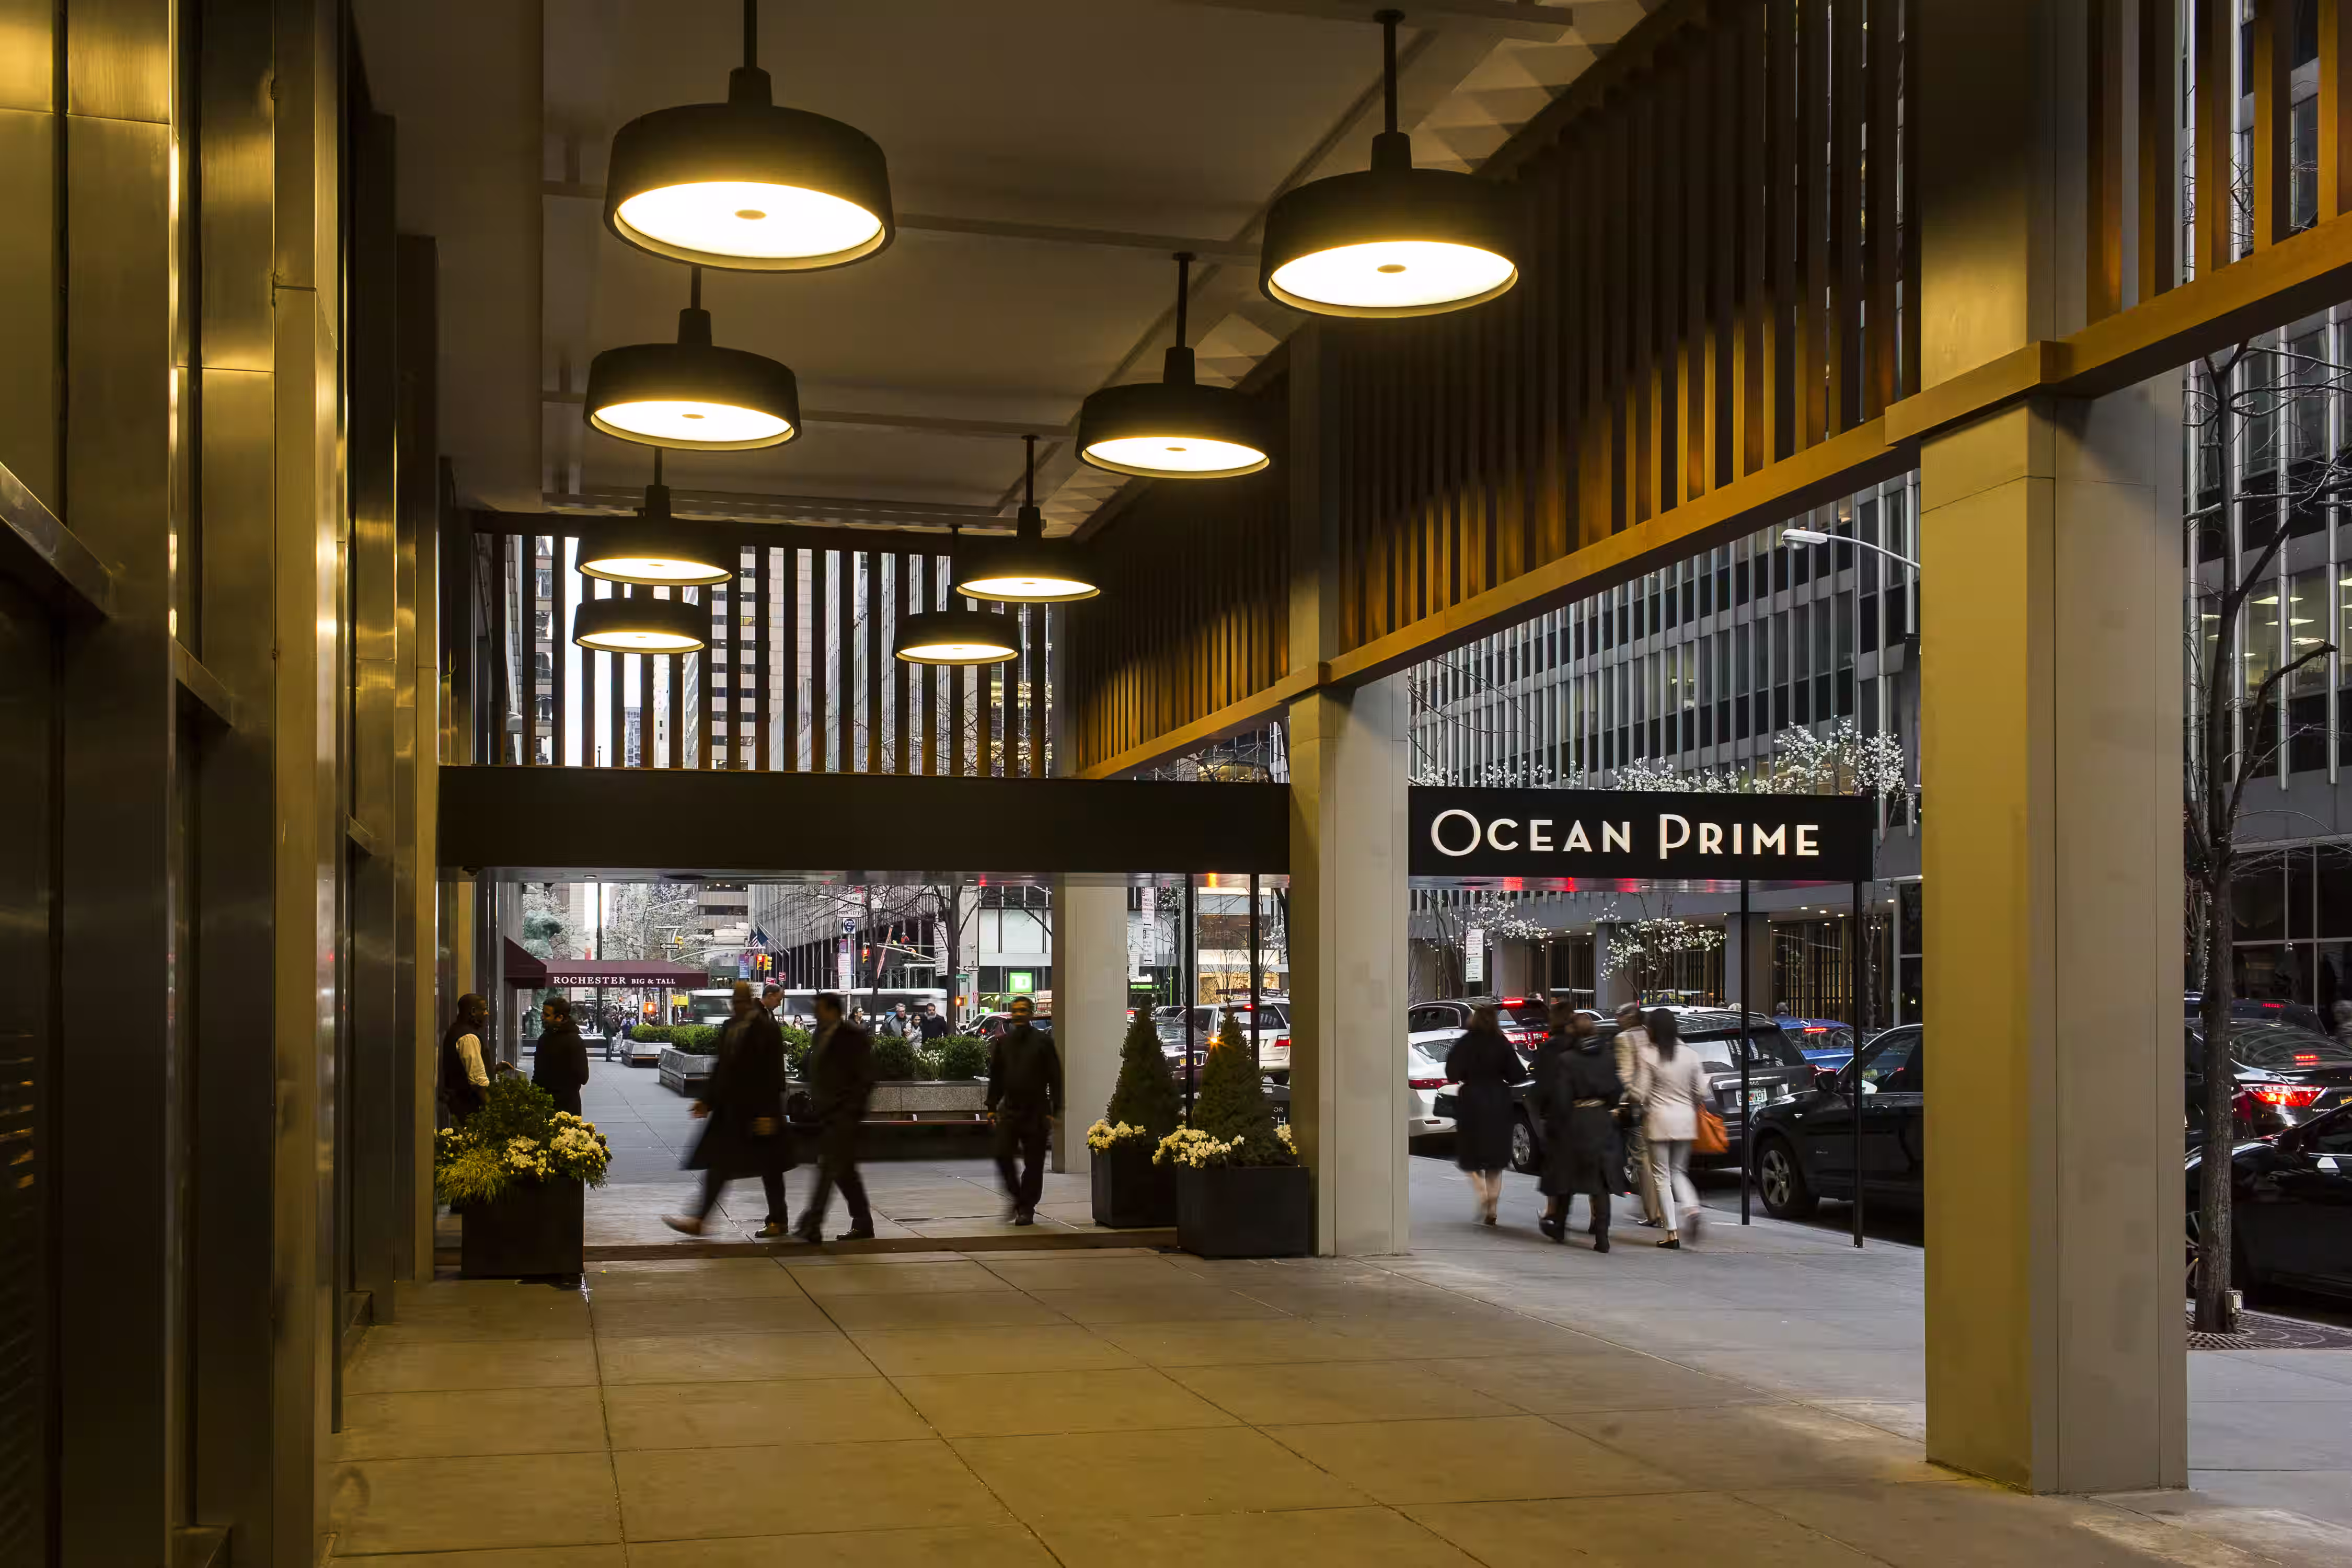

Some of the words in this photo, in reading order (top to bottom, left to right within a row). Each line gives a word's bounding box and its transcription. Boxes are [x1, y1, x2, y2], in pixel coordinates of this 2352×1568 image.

[1431, 809, 1631, 857] OCEAN
[1659, 814, 1819, 860] PRIME
[1012, 976, 1030, 988] TD
